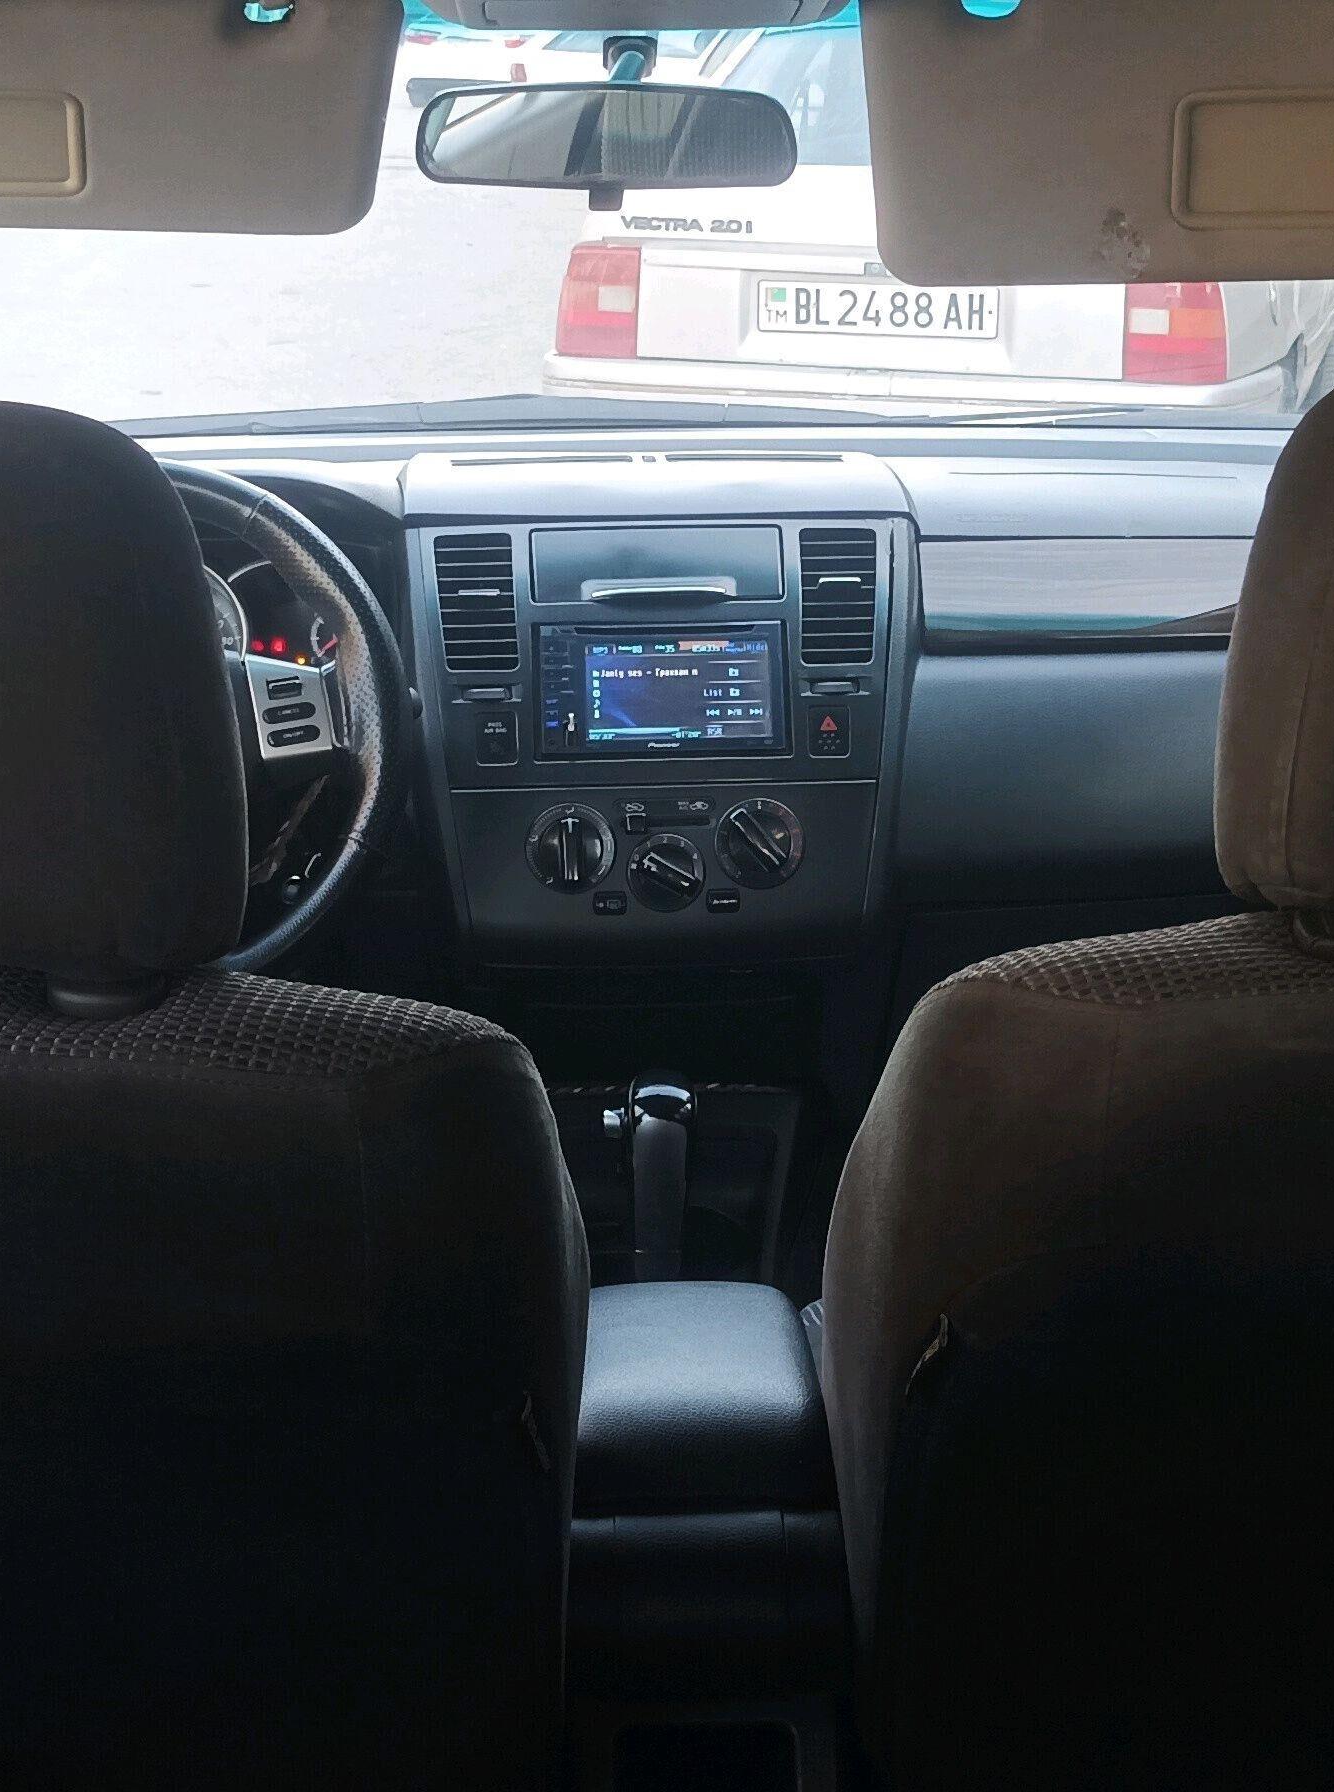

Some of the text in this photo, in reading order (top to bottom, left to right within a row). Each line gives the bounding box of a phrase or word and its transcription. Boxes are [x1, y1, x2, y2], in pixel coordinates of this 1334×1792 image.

[620, 215, 704, 232] VECTRA
[766, 308, 788, 324] TM
[703, 688, 723, 697] List
